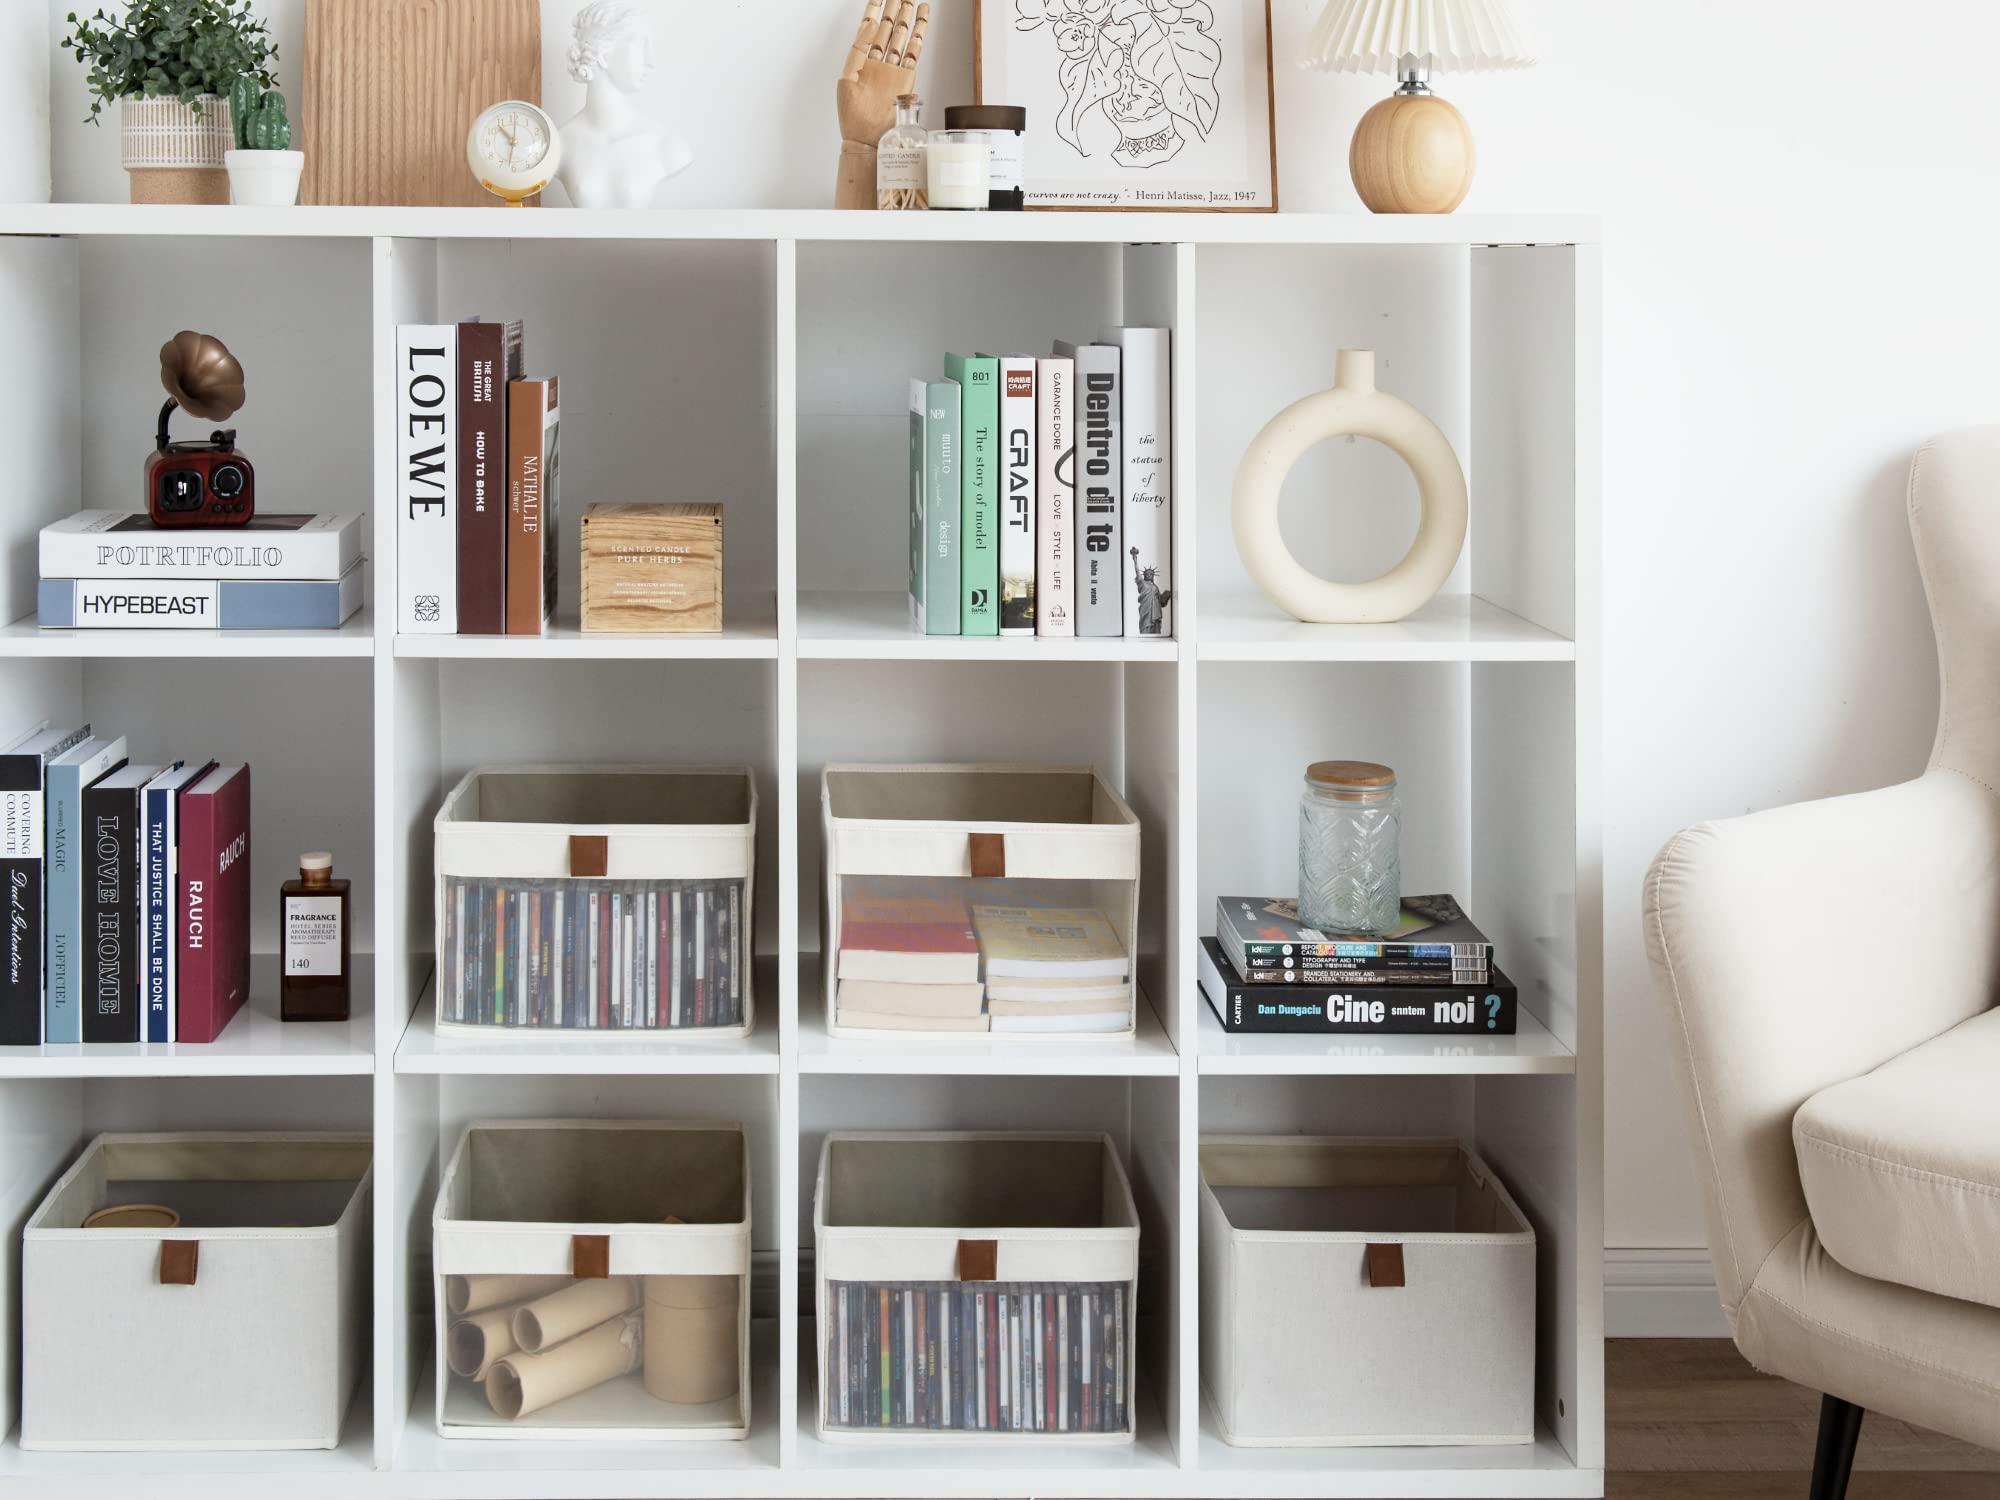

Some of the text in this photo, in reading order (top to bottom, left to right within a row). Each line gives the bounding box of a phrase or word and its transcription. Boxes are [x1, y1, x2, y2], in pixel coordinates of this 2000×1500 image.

[1076, 191, 1092, 199] not
[1135, 190, 1165, 200] Henri
[1167, 190, 1206, 201] Matisse,
[1208, 191, 1232, 203] Jazz,
[1234, 191, 1256, 201] 1947
[473, 360, 482, 402] BRITISH
[484, 360, 492, 402] THE GREAT
[972, 371, 989, 381] 801
[930, 409, 946, 419] NEW
[1053, 372, 1061, 450] GARANCE DORE
[1086, 373, 1114, 476] Dentro
[408, 346, 446, 521] LOEWE
[942, 433, 952, 474] muuto
[1139, 434, 1155, 445] the
[475, 431, 485, 512] HOW TO BAKE
[1010, 428, 1029, 533] CRAFT
[1131, 456, 1163, 464] statue
[1142, 472, 1156, 488] of
[512, 480, 520, 513] schwer
[523, 455, 538, 533] NATHALIE
[973, 427, 987, 549] The story of model
[1086, 487, 1114, 513] di
[1132, 492, 1166, 508] liberty
[97, 545, 283, 567] POTRTFOLIO
[938, 520, 951, 557] design
[1053, 494, 1061, 591] LOVE STYLE LIFE
[1086, 523, 1113, 553] te
[617, 555, 683, 564] PURE HERBS
[83, 595, 210, 614] HYPEBEAST
[6, 793, 16, 854] COMMUTE
[22, 793, 31, 855] COVERING
[56, 829, 66, 873] MAGIC
[219, 832, 245, 874] RAUCH
[97, 816, 120, 1014] LOVE HOME
[152, 822, 162, 1011] THAT JUSTICE SHALL BE DONE
[189, 880, 203, 949] RAUCH
[55, 934, 66, 1009] L'OFFICIEL
[292, 959, 310, 969] 140
[1258, 1004, 1321, 1016] Dan Dungaciu
[1327, 995, 1385, 1023] Cine
[1434, 995, 1475, 1023] noi
[1484, 994, 1501, 1029] ?
